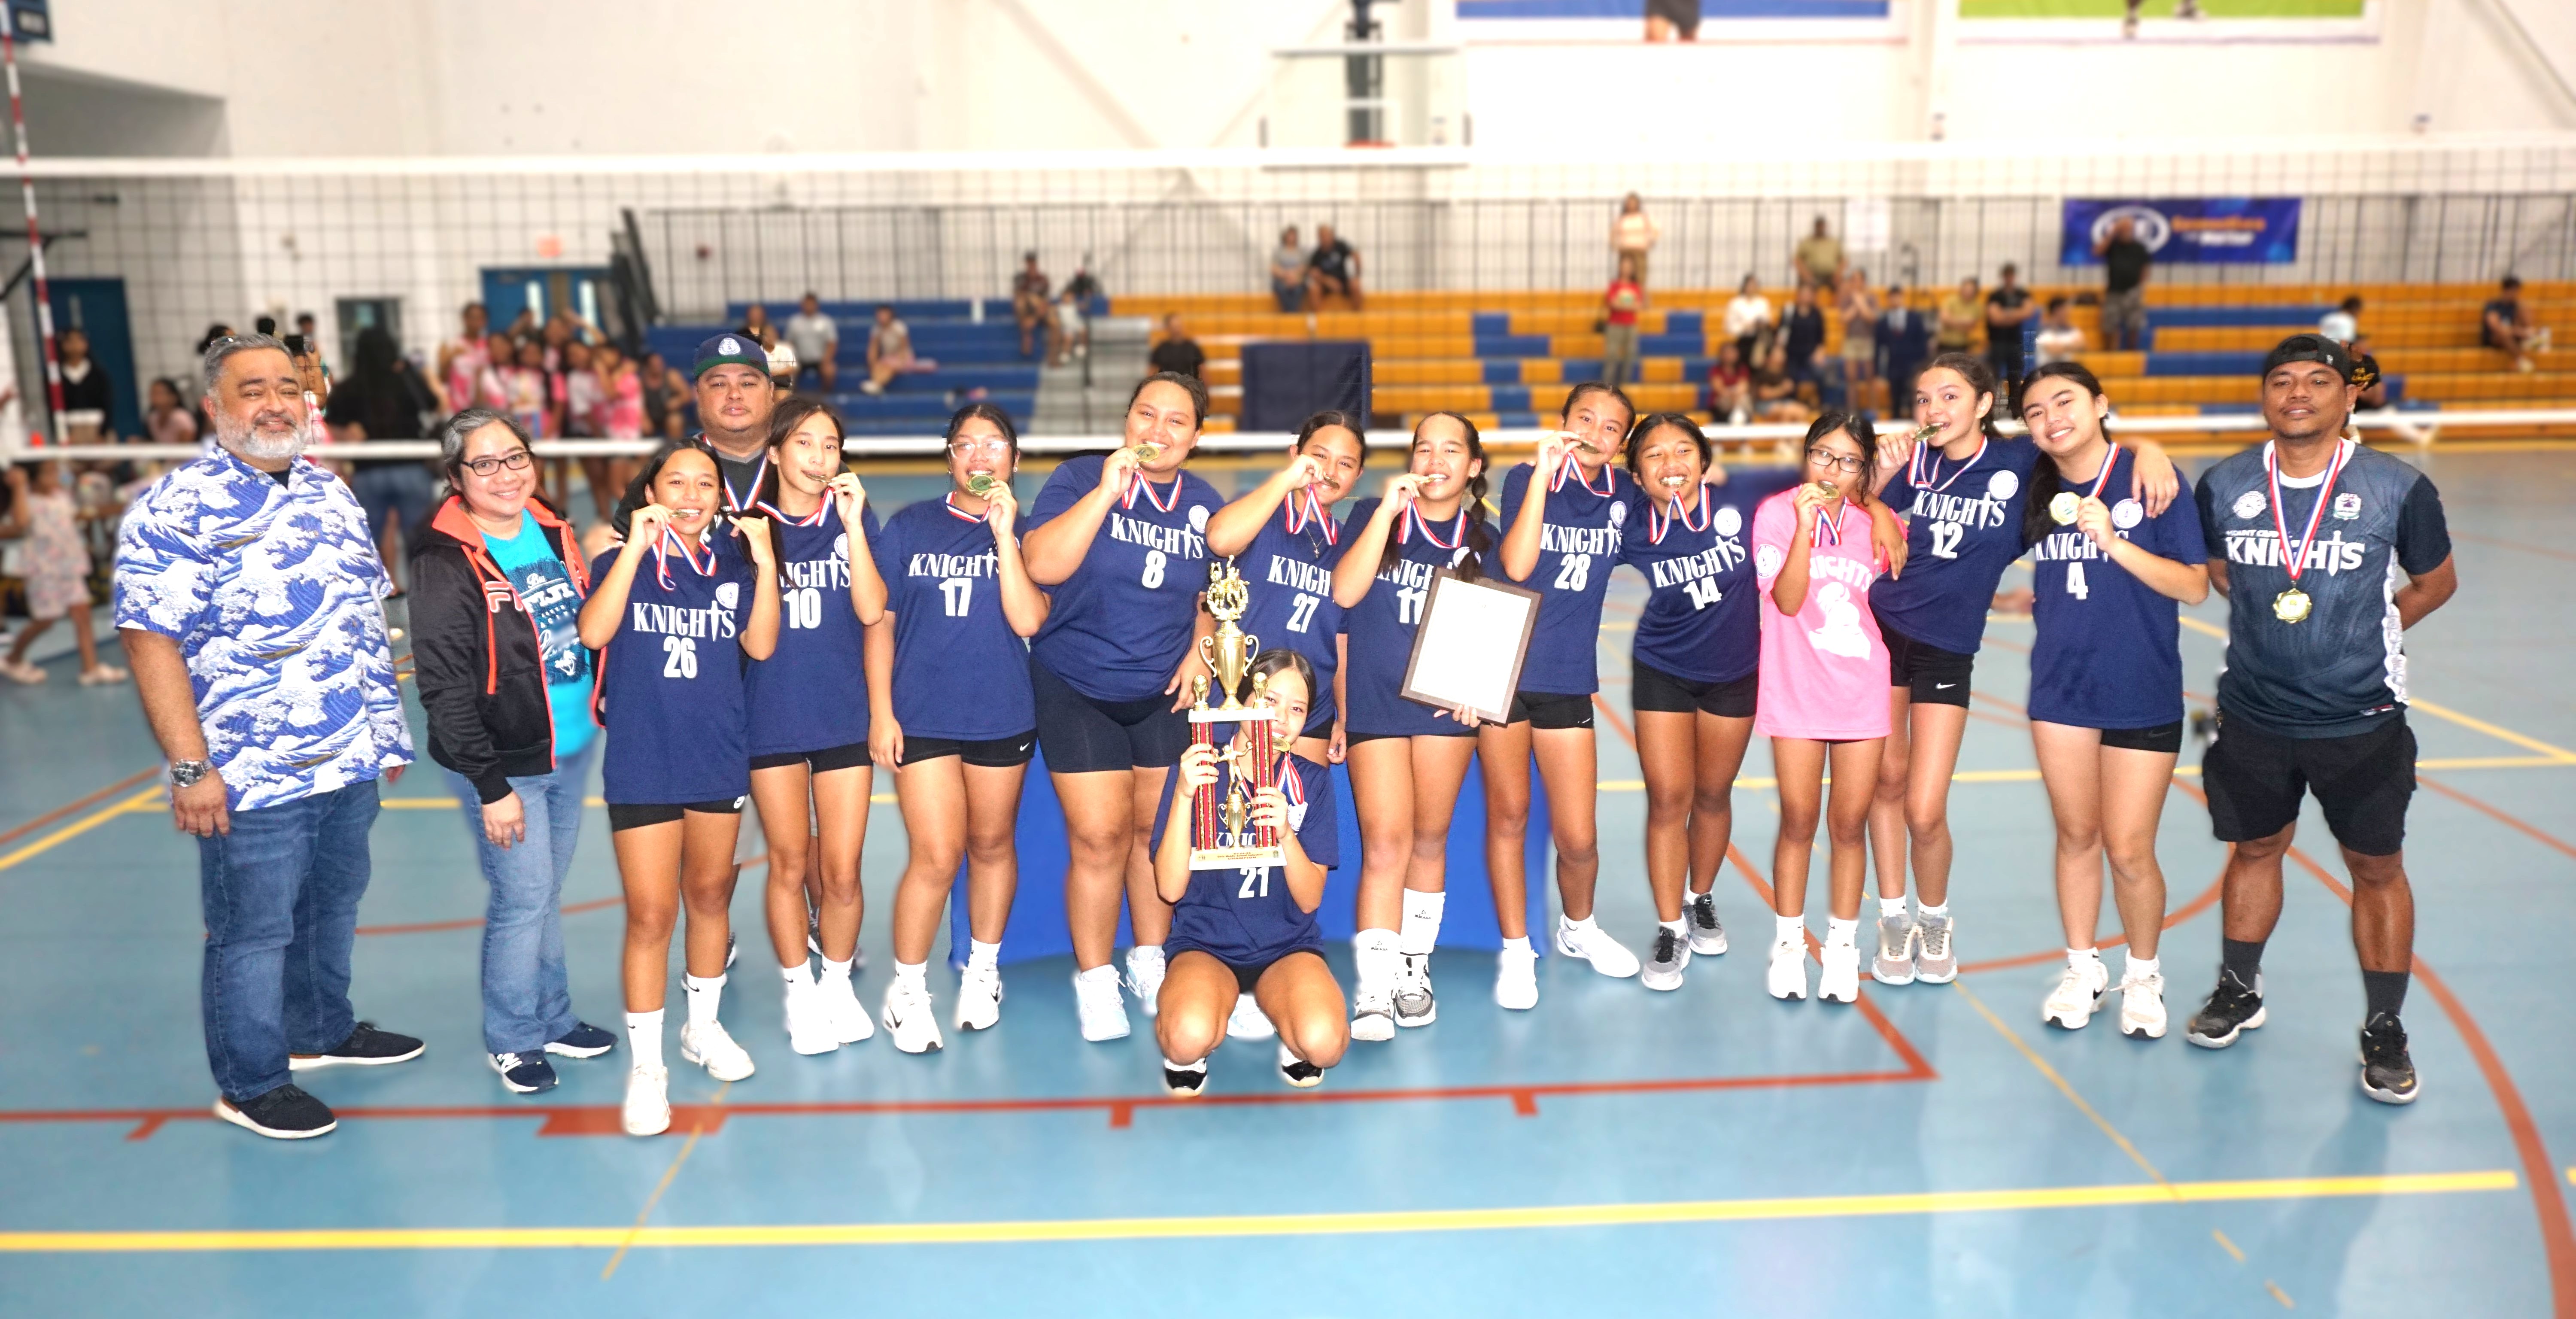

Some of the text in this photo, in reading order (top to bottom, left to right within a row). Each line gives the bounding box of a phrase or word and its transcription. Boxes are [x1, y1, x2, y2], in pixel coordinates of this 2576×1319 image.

[1913, 490, 2006, 530] KNIGHTS
[1110, 513, 1204, 559] KNIGHTS
[1540, 520, 1623, 557] KNIGHTS
[1929, 520, 1963, 558] 12
[908, 548, 999, 579] KNIGHT
[1142, 550, 1166, 588] 8
[1266, 554, 1331, 596] KNIGH
[1554, 553, 1591, 591] 28
[1652, 535, 1745, 587] KNIGHTS
[939, 577, 972, 616] 17
[1683, 576, 1722, 610] 14
[2066, 562, 2088, 599] 4
[632, 600, 735, 641] KNIGHTS
[783, 588, 821, 629] 10
[1286, 593, 1320, 633] 27
[1396, 587, 1428, 624] 11
[663, 636, 698, 678] 26
[1239, 866, 1269, 898] 21
